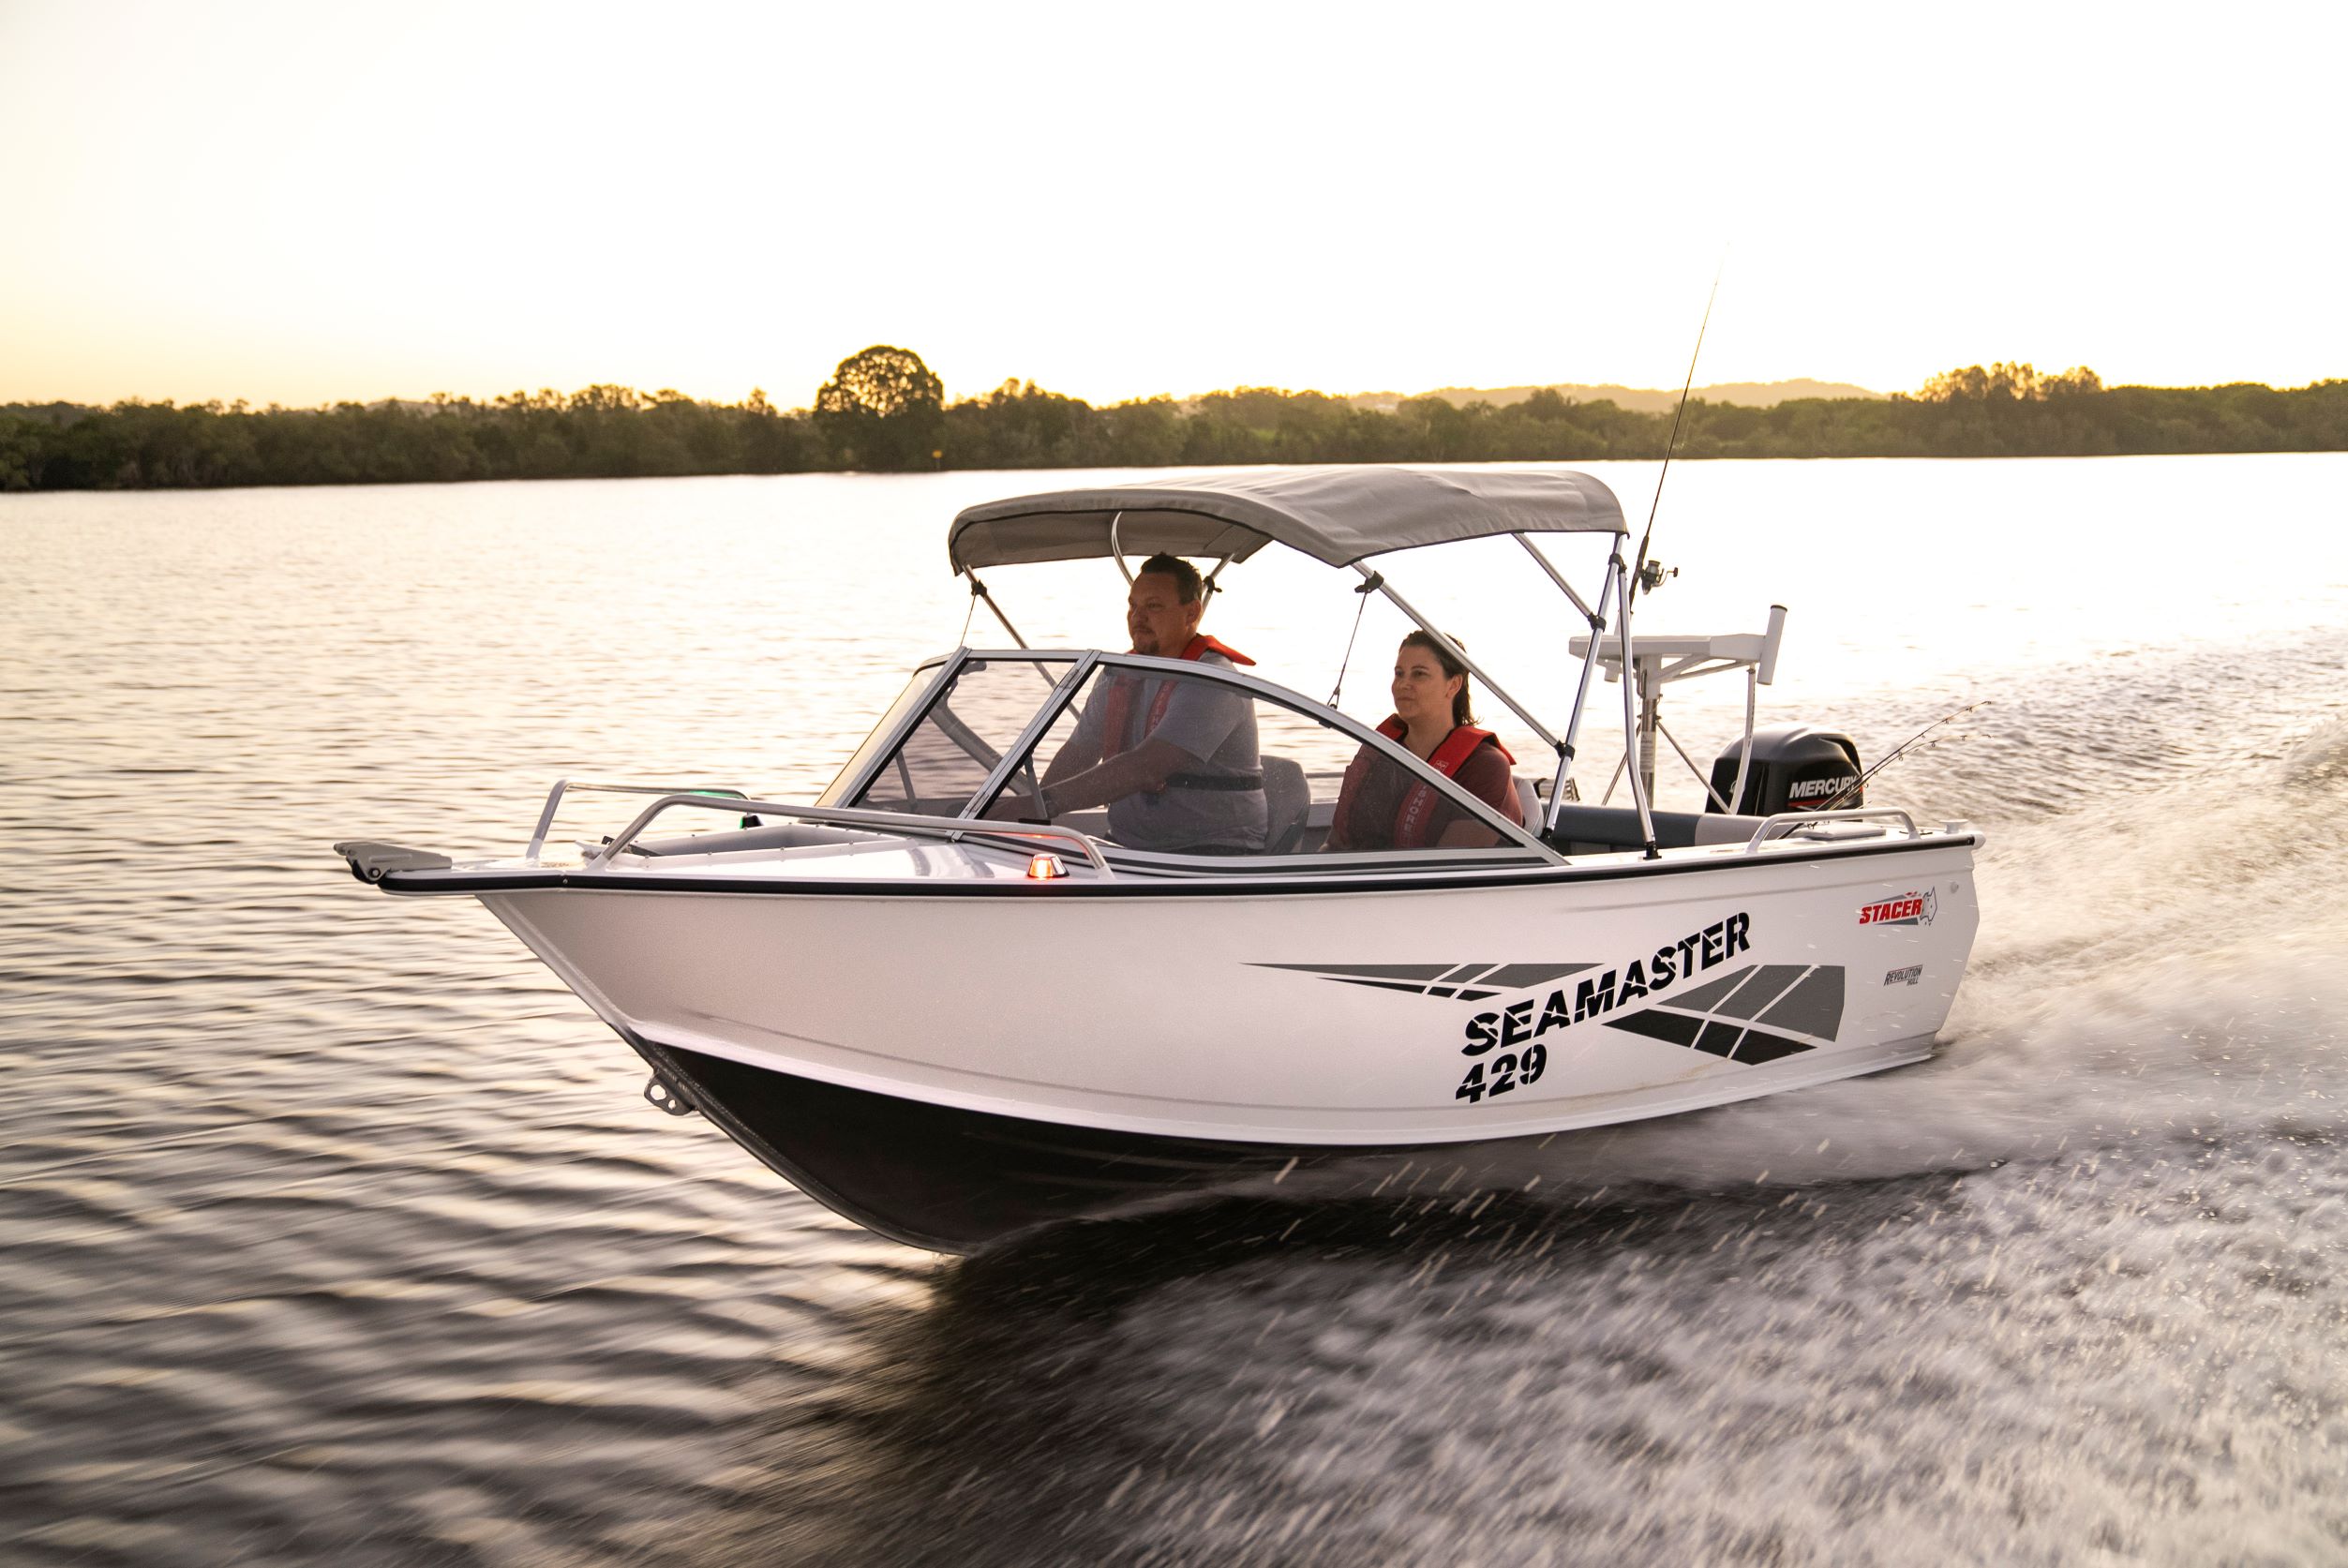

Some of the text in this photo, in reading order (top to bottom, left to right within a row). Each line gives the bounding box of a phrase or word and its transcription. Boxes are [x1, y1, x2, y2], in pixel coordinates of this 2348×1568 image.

[1859, 899, 1922, 924] STACER
[1461, 912, 1751, 1056] SEAMASTER
[1456, 1044, 1547, 1103] 429
